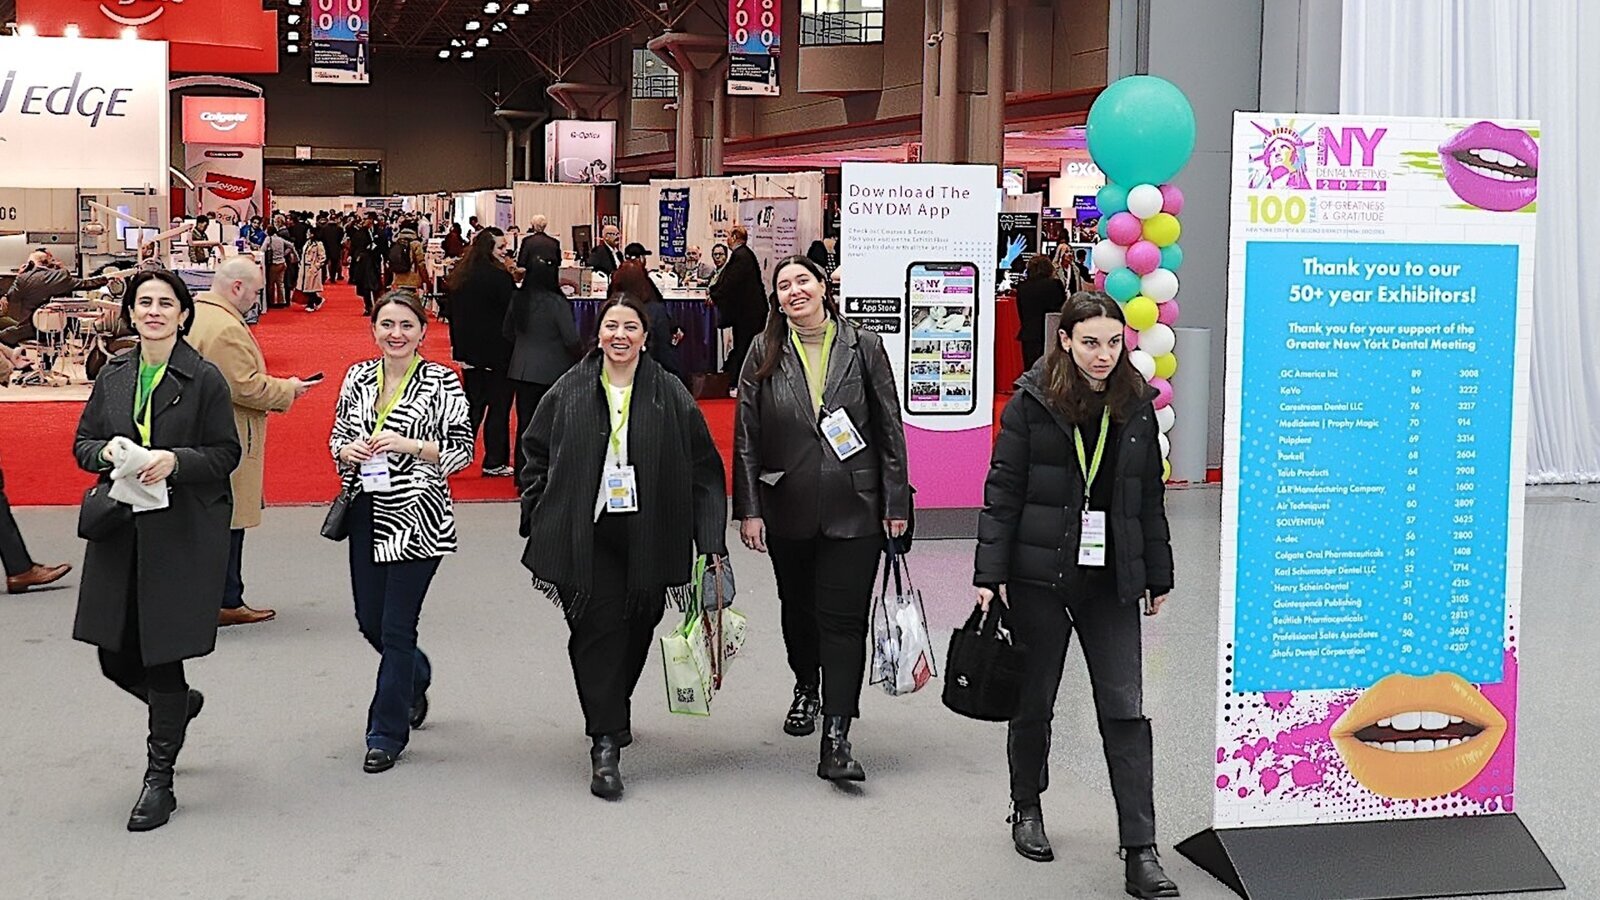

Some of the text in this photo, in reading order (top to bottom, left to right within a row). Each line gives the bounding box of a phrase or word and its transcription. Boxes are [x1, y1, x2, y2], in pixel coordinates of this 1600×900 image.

[1325, 126, 1388, 167] NY
[1316, 168, 1348, 178] DENTAL
[849, 184, 971, 200] Download The
[1323, 180, 1381, 191] 2024
[848, 202, 950, 219] GNYDM App
[1247, 195, 1317, 225] 100 YEARS
[1320, 201, 1386, 211] OF GREATNESS
[1322, 212, 1385, 222] & GRATITUDE
[1302, 257, 1462, 281] Thank you to our
[1288, 284, 1477, 307] 50+ year Exhibitors!
[862, 304, 897, 313] App Store
[862, 323, 898, 332] Google Play
[1288, 322, 1475, 337] Thank you for your support of the
[1286, 338, 1476, 352] Greater New York Dental Meeting
[1280, 369, 1479, 379] GC America Inc 89 3008
[1411, 385, 1421, 394] 86
[1458, 385, 1478, 394] 3222
[1280, 402, 1476, 411] Carestream Dental LLC 76 3217
[1279, 419, 1320, 428] Medidenta
[1327, 418, 1354, 429] Prophy
[1355, 419, 1380, 429] Magic
[1409, 419, 1420, 427] 70
[1457, 418, 1471, 427] 914
[1279, 433, 1475, 446] Pulpdent 69 3314
[1278, 450, 1476, 461] Parkell 68 2604
[1277, 466, 1475, 477] Taub Products 64 2908
[1277, 485, 1293, 494] L&R
[1293, 485, 1348, 495] Manufacturing
[1406, 483, 1416, 492] 61
[1455, 482, 1474, 491] 1600
[1276, 502, 1288, 510] Air
[1289, 501, 1330, 511] Techniques
[1406, 499, 1417, 508] 60
[1275, 515, 1473, 527] SOLVENTUM 57 3625
[1275, 531, 1473, 543] A-dec 56 2800
[1275, 547, 1472, 561] Colgate Oral Pharmaceuticals 56 1408
[1274, 563, 1469, 576] Karl Schumacher Dental LLC 52 1714
[1274, 579, 1470, 593] Henry Schein Dental 51 4215
[1273, 594, 1469, 608] Quintessence Publishing 51 3105
[1303, 614, 1363, 624] Pharmaceuticals
[1450, 611, 1468, 619] 2813
[1272, 626, 1469, 641] Professional Sales Associates 50 3603
[1272, 642, 1469, 657] Shofu Dental Corporation 50 4207
